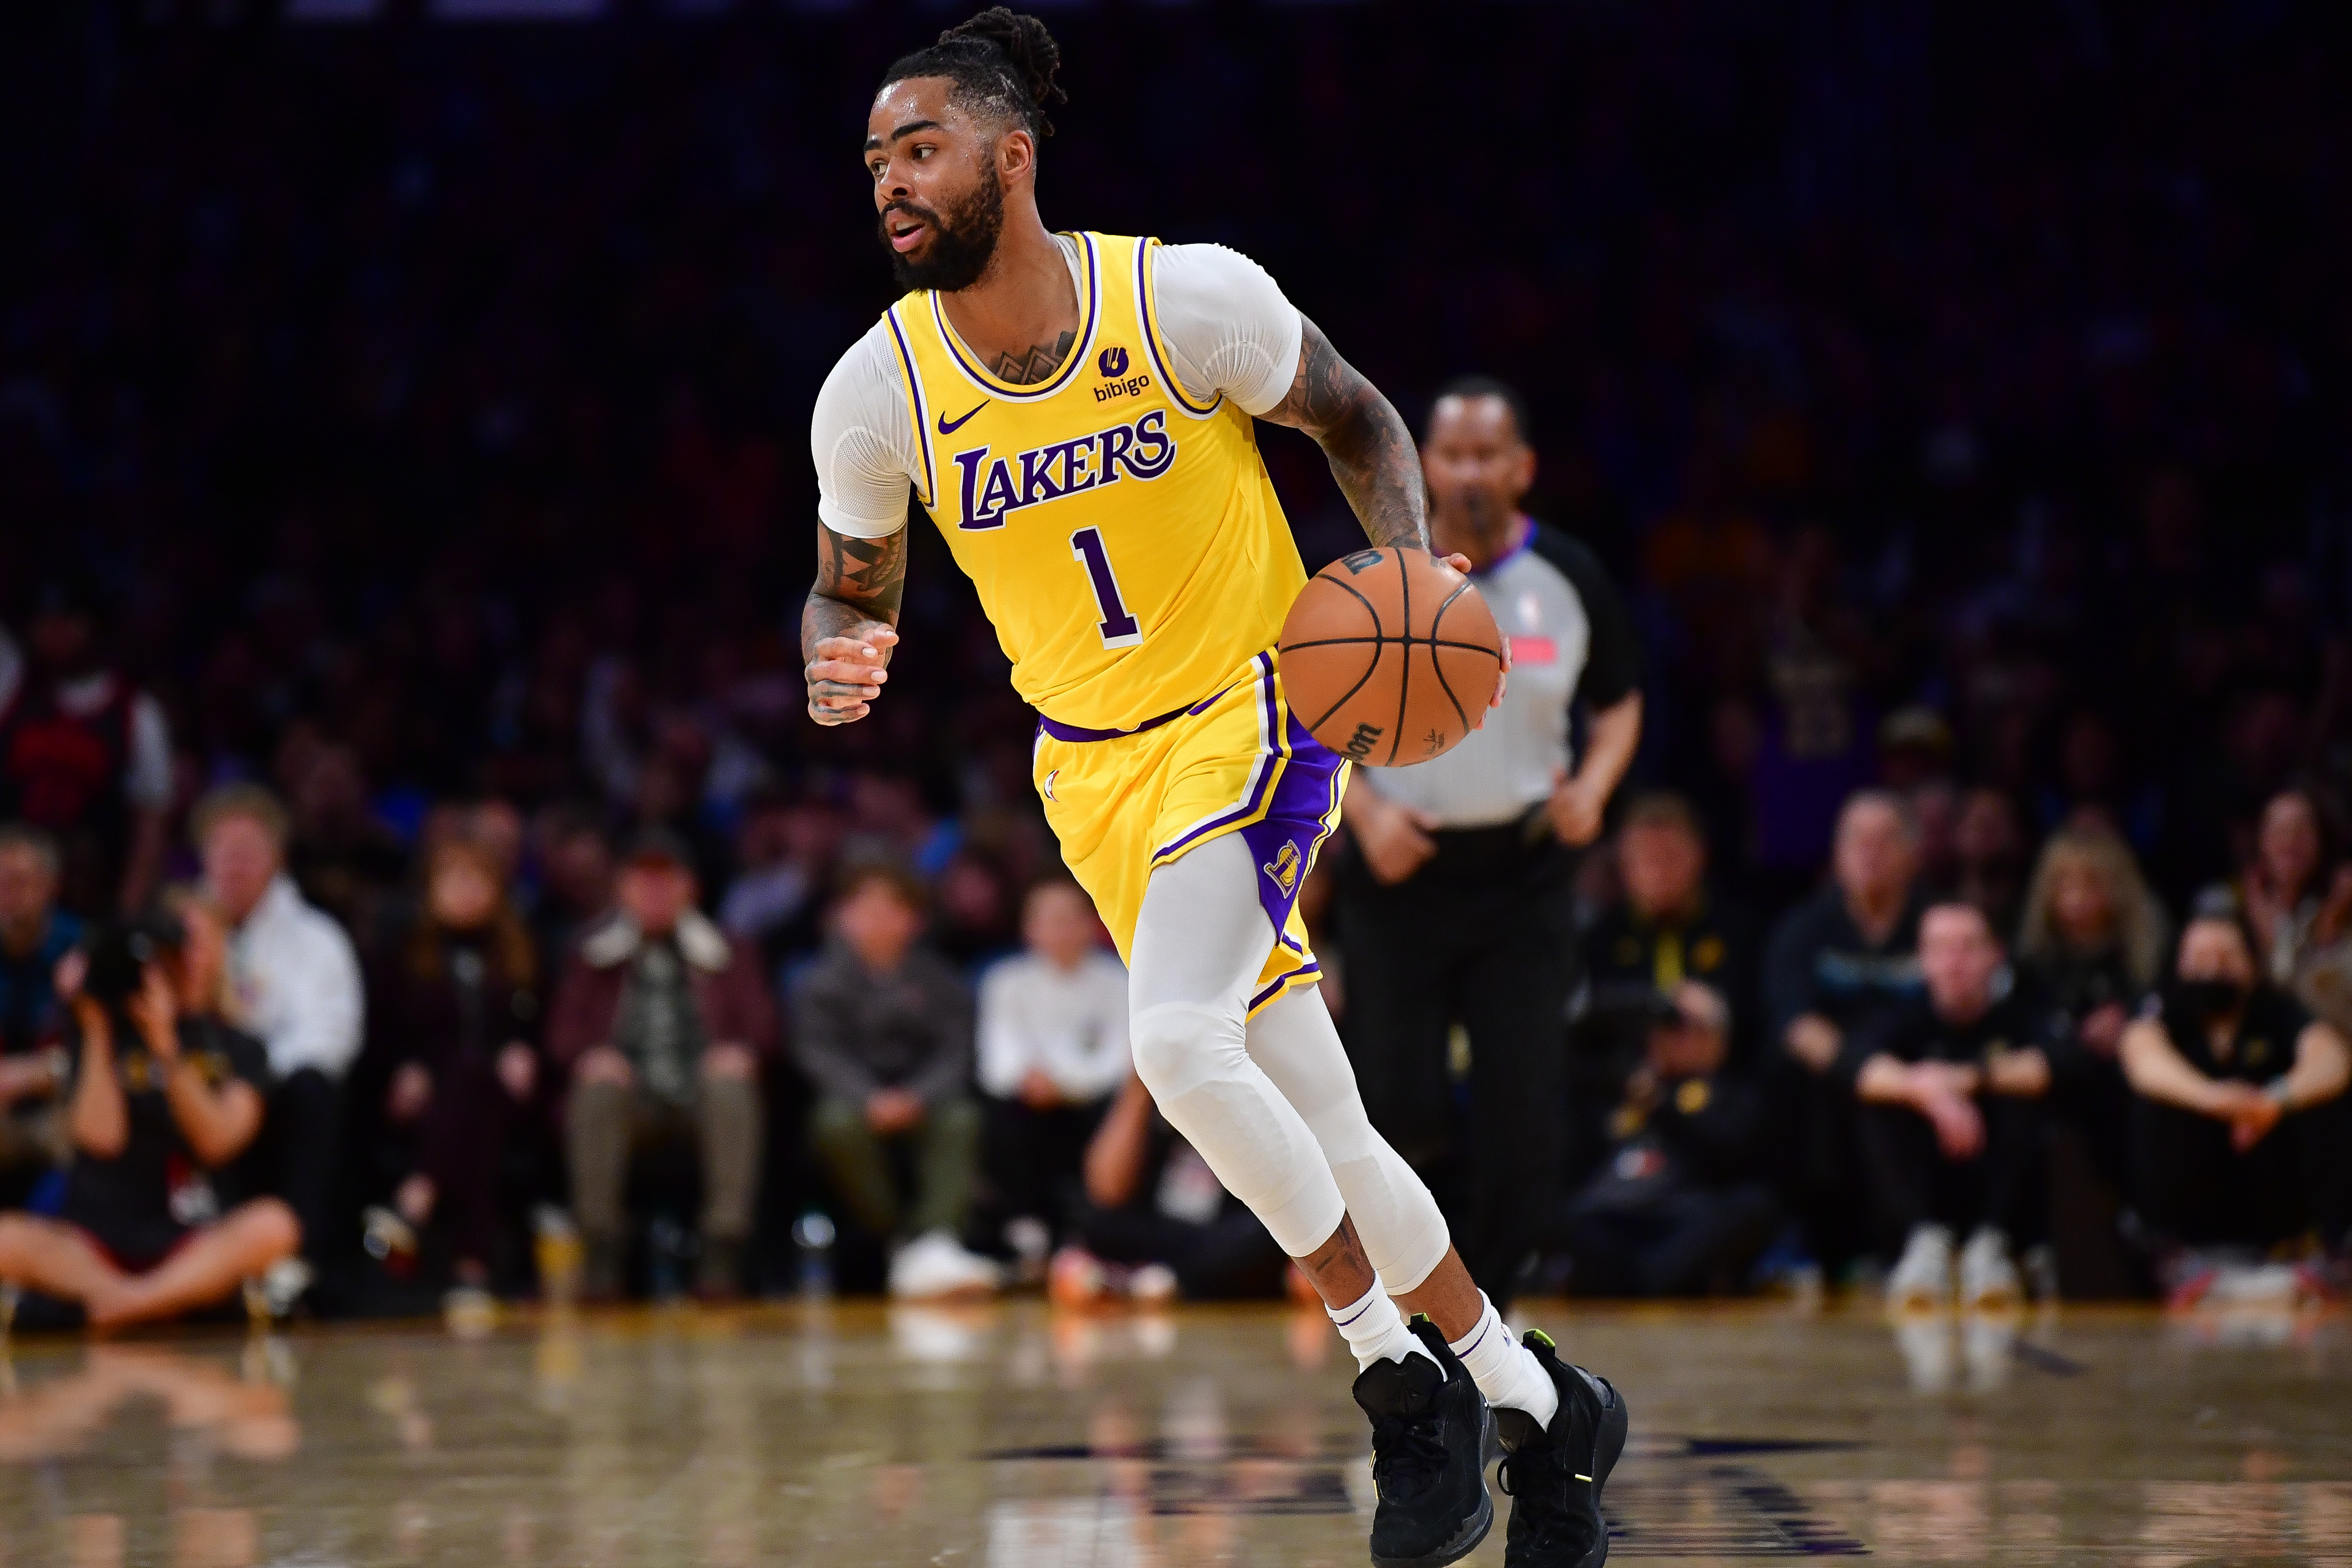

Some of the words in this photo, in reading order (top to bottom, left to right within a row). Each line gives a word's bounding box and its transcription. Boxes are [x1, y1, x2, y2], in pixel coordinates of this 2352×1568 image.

[1093, 375, 1150, 402] bibigo
[952, 409, 1177, 532] LAKERS
[1068, 525, 1144, 650] 1
